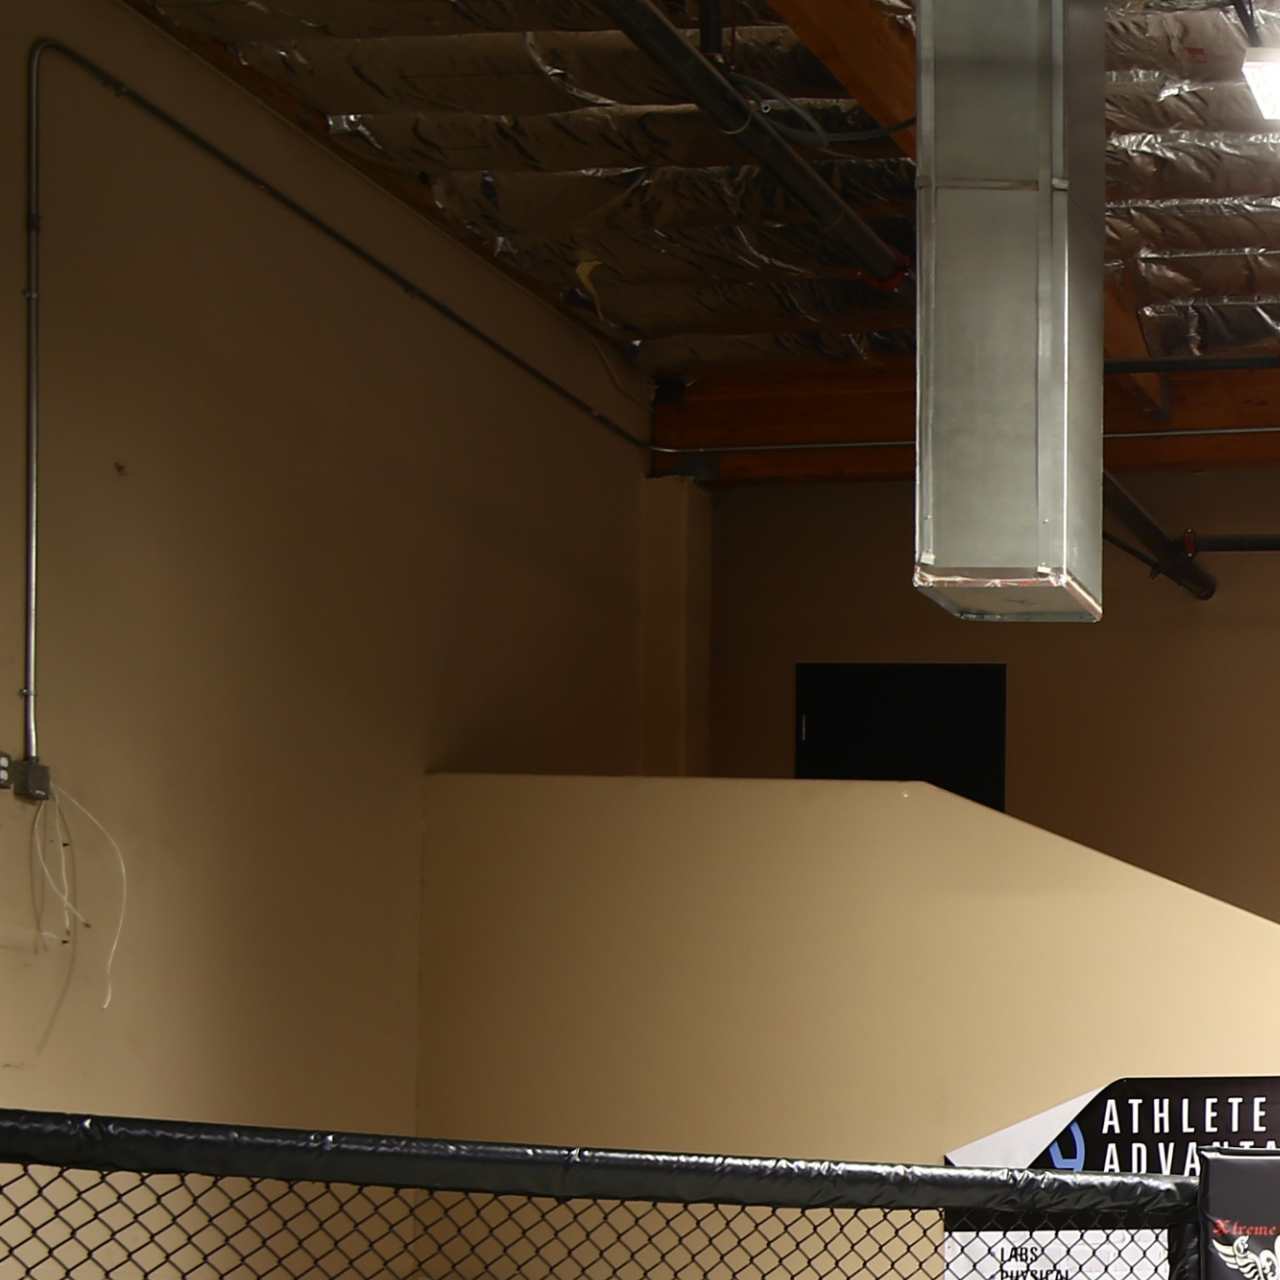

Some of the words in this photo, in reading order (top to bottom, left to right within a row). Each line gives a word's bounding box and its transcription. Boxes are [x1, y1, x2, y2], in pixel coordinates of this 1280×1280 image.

[1101, 1096, 1268, 1135] ATHLETE
[1212, 1219, 1277, 1237] Xtreme
[1000, 1246, 1039, 1263] LABS
